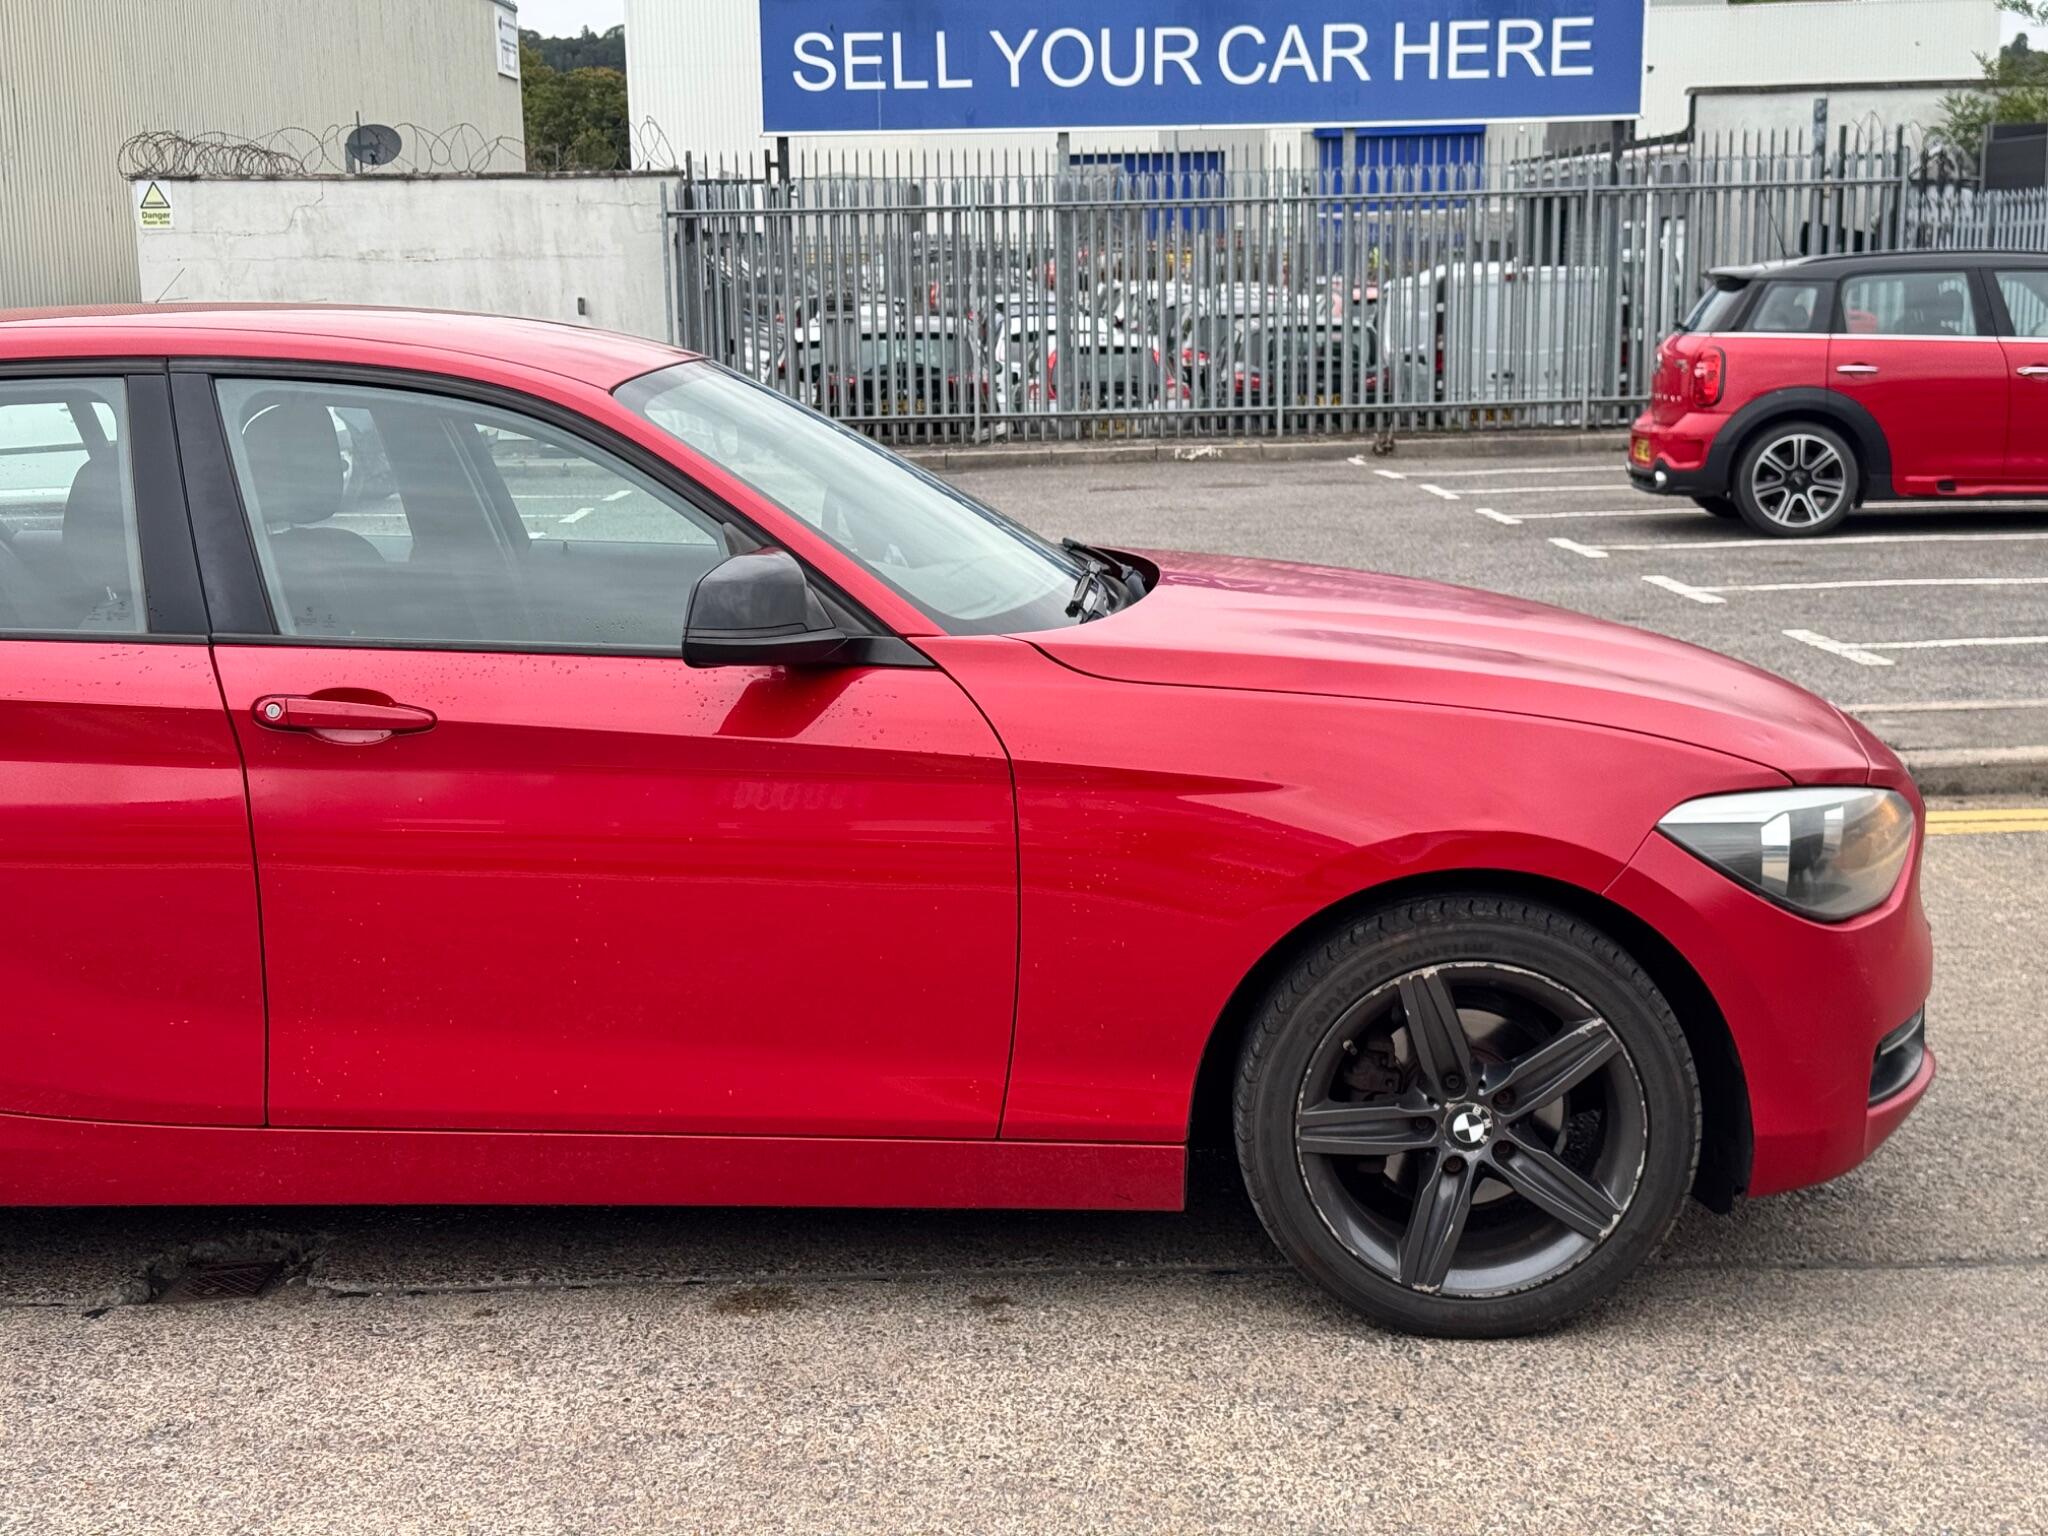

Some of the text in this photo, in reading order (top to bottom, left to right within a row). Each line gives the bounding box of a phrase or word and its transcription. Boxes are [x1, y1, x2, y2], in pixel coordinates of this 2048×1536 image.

[792, 16, 1595, 92] SELL YOUR CAR HERE
[142, 211, 170, 220] Danger
